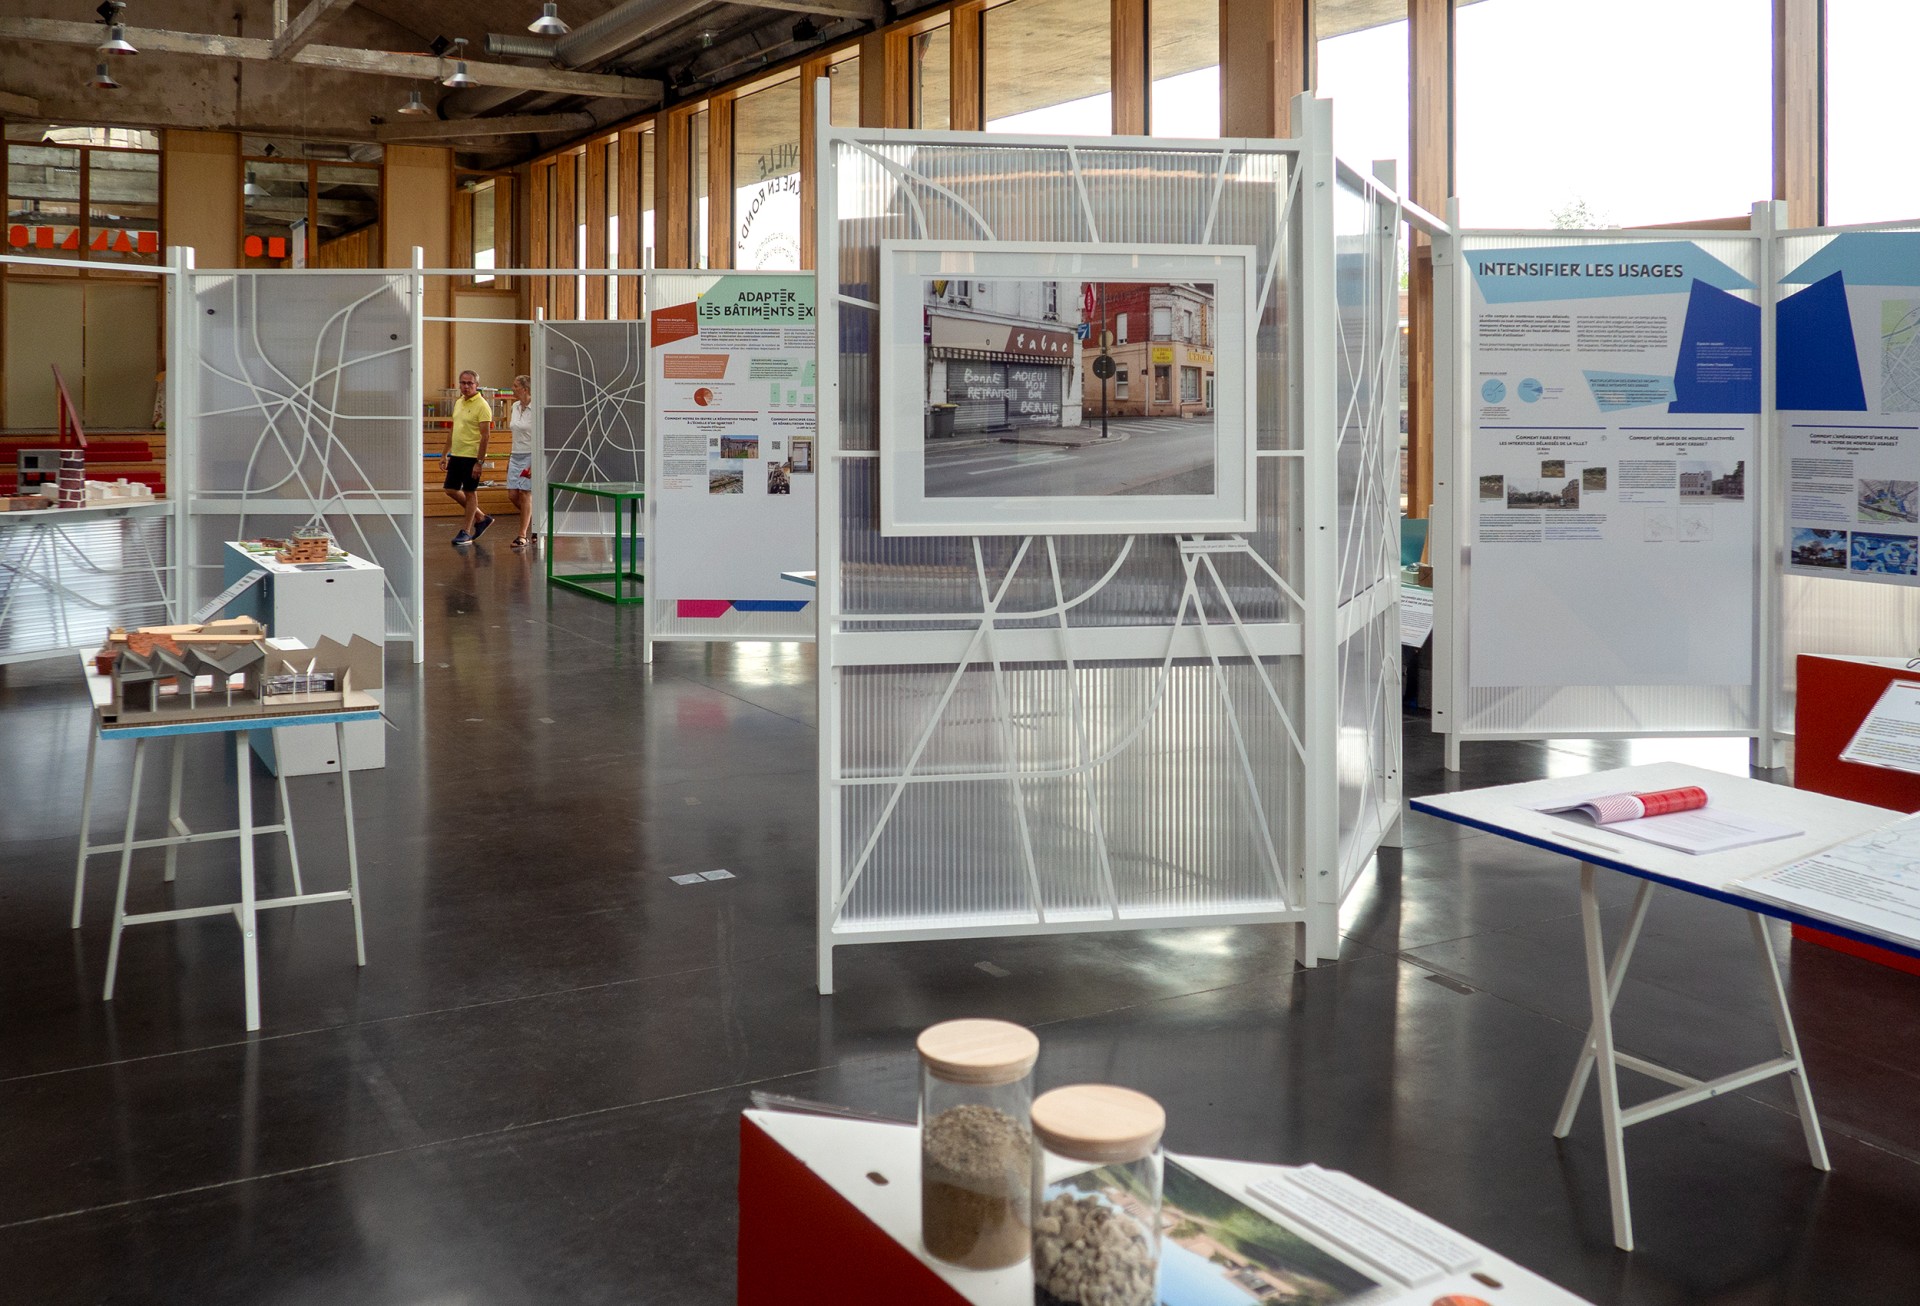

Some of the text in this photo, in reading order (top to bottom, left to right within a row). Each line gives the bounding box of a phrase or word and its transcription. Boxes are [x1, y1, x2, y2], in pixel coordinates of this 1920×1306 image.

[1480, 262, 1683, 278] INTENSIFIER LES USAGES
[738, 289, 796, 305] ADAPTER
[700, 303, 720, 319] LES
[724, 303, 794, 320] BÂTIMENTS
[1016, 332, 1068, 354] tabac
[1020, 401, 1058, 413] BERNIE
